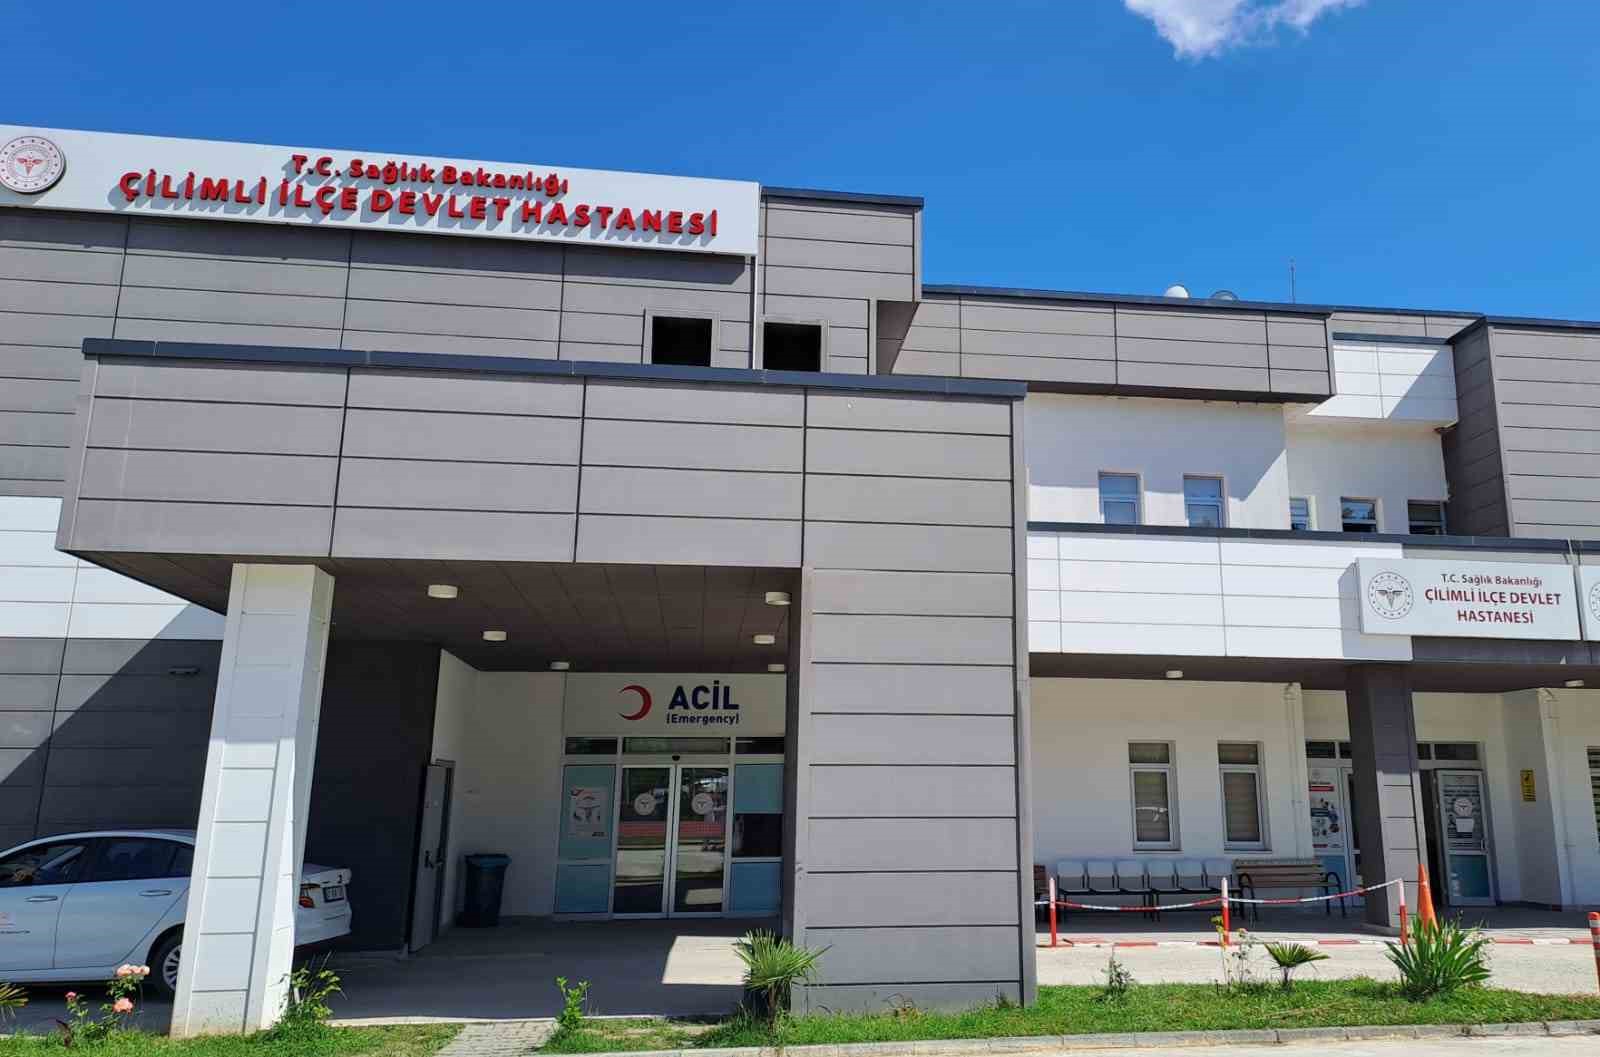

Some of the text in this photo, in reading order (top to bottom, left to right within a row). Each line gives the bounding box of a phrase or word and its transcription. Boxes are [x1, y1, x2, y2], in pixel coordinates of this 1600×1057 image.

[292, 154, 568, 197] T.C. Sağlık Bakanlığı
[119, 169, 718, 237] ÇİLİMLİ İLÇE DEVLET HASTANESİ
[1441, 573, 1543, 588] T.C. Sağlık Bakanlığı
[1424, 588, 1561, 605] ÇİLİMLİ İLÇE DEVLET
[1457, 609, 1534, 624] HASTANESİ
[669, 680, 739, 709] ACİL
